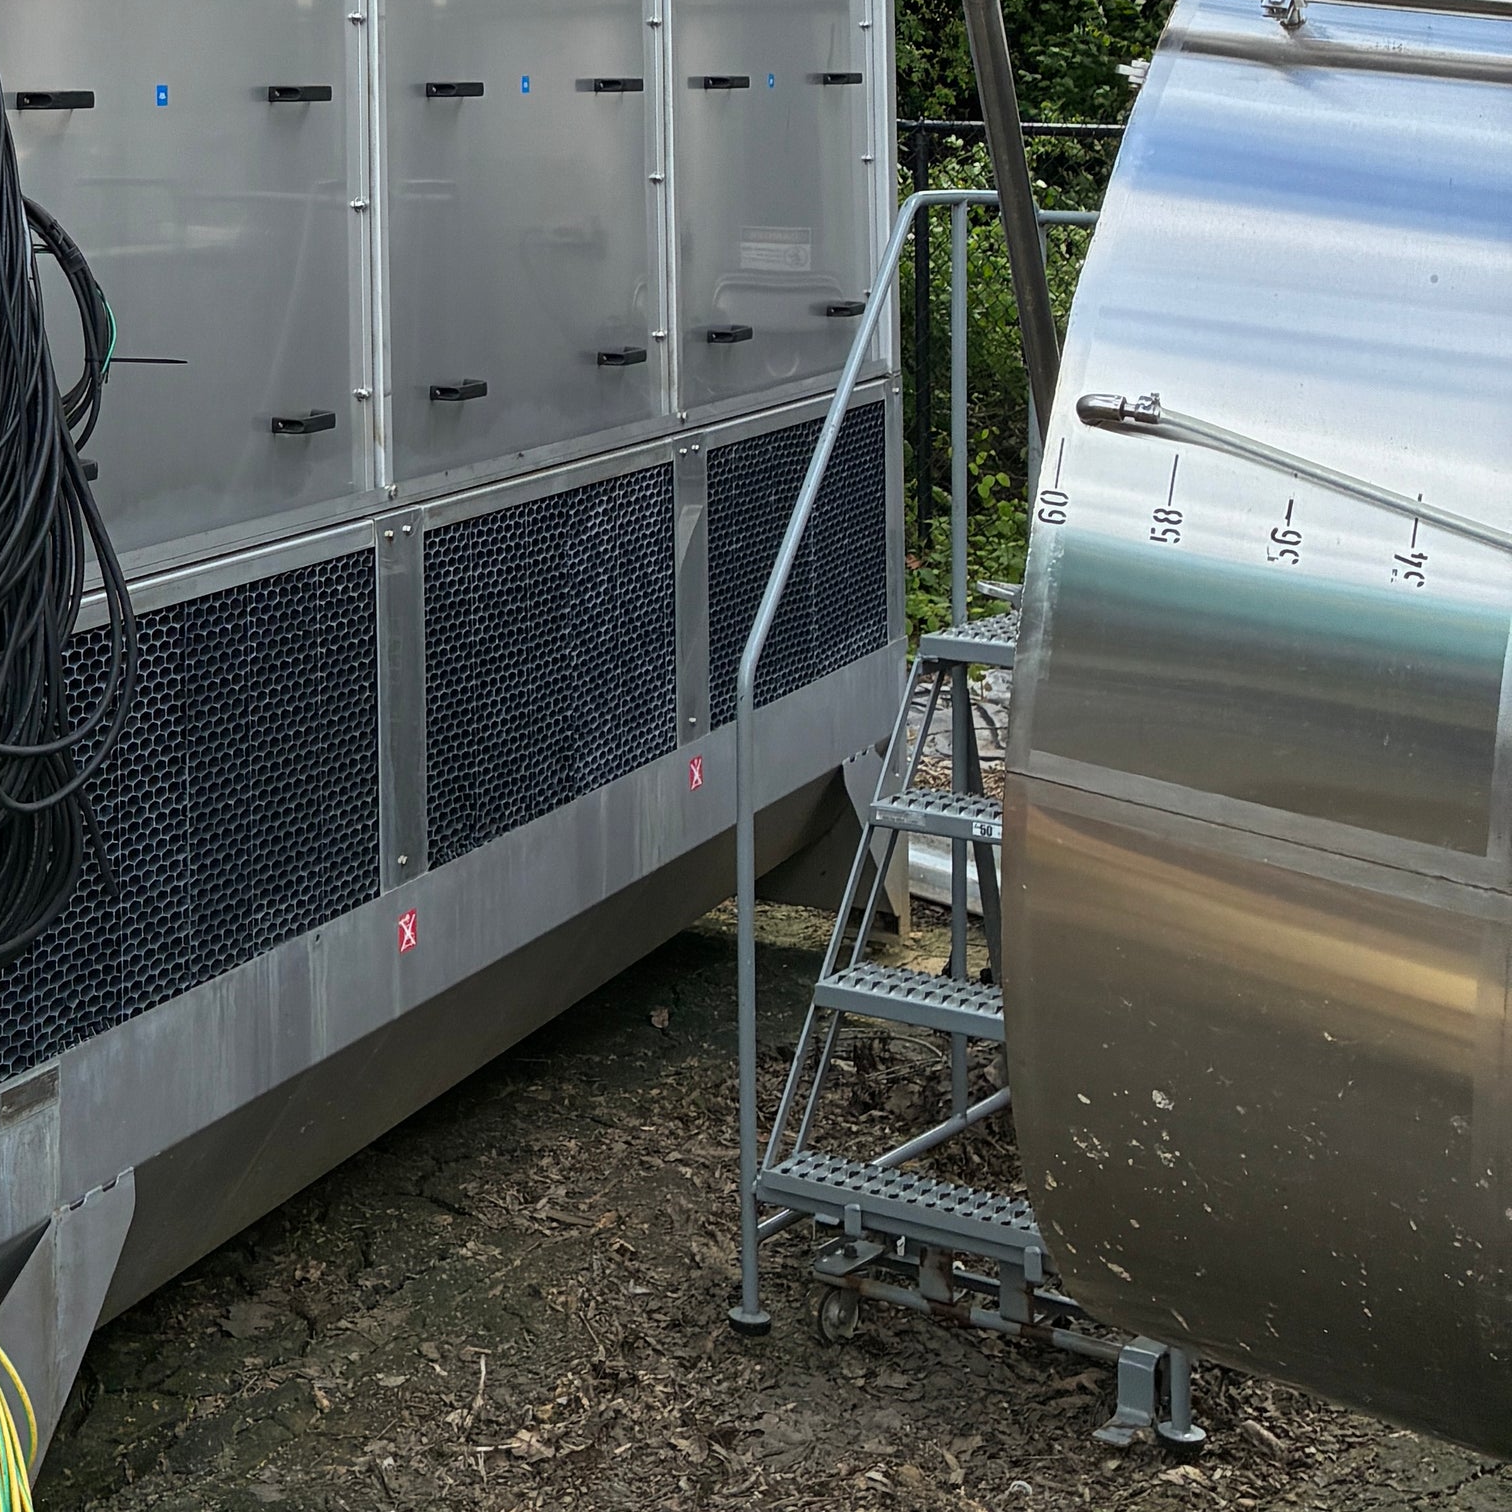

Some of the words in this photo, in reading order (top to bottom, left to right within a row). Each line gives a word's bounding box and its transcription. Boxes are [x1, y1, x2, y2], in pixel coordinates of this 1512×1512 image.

[1037, 489, 1070, 525] 60
[1149, 508, 1183, 544] 58
[1266, 527, 1303, 565] 56
[1390, 552, 1429, 588] 54
